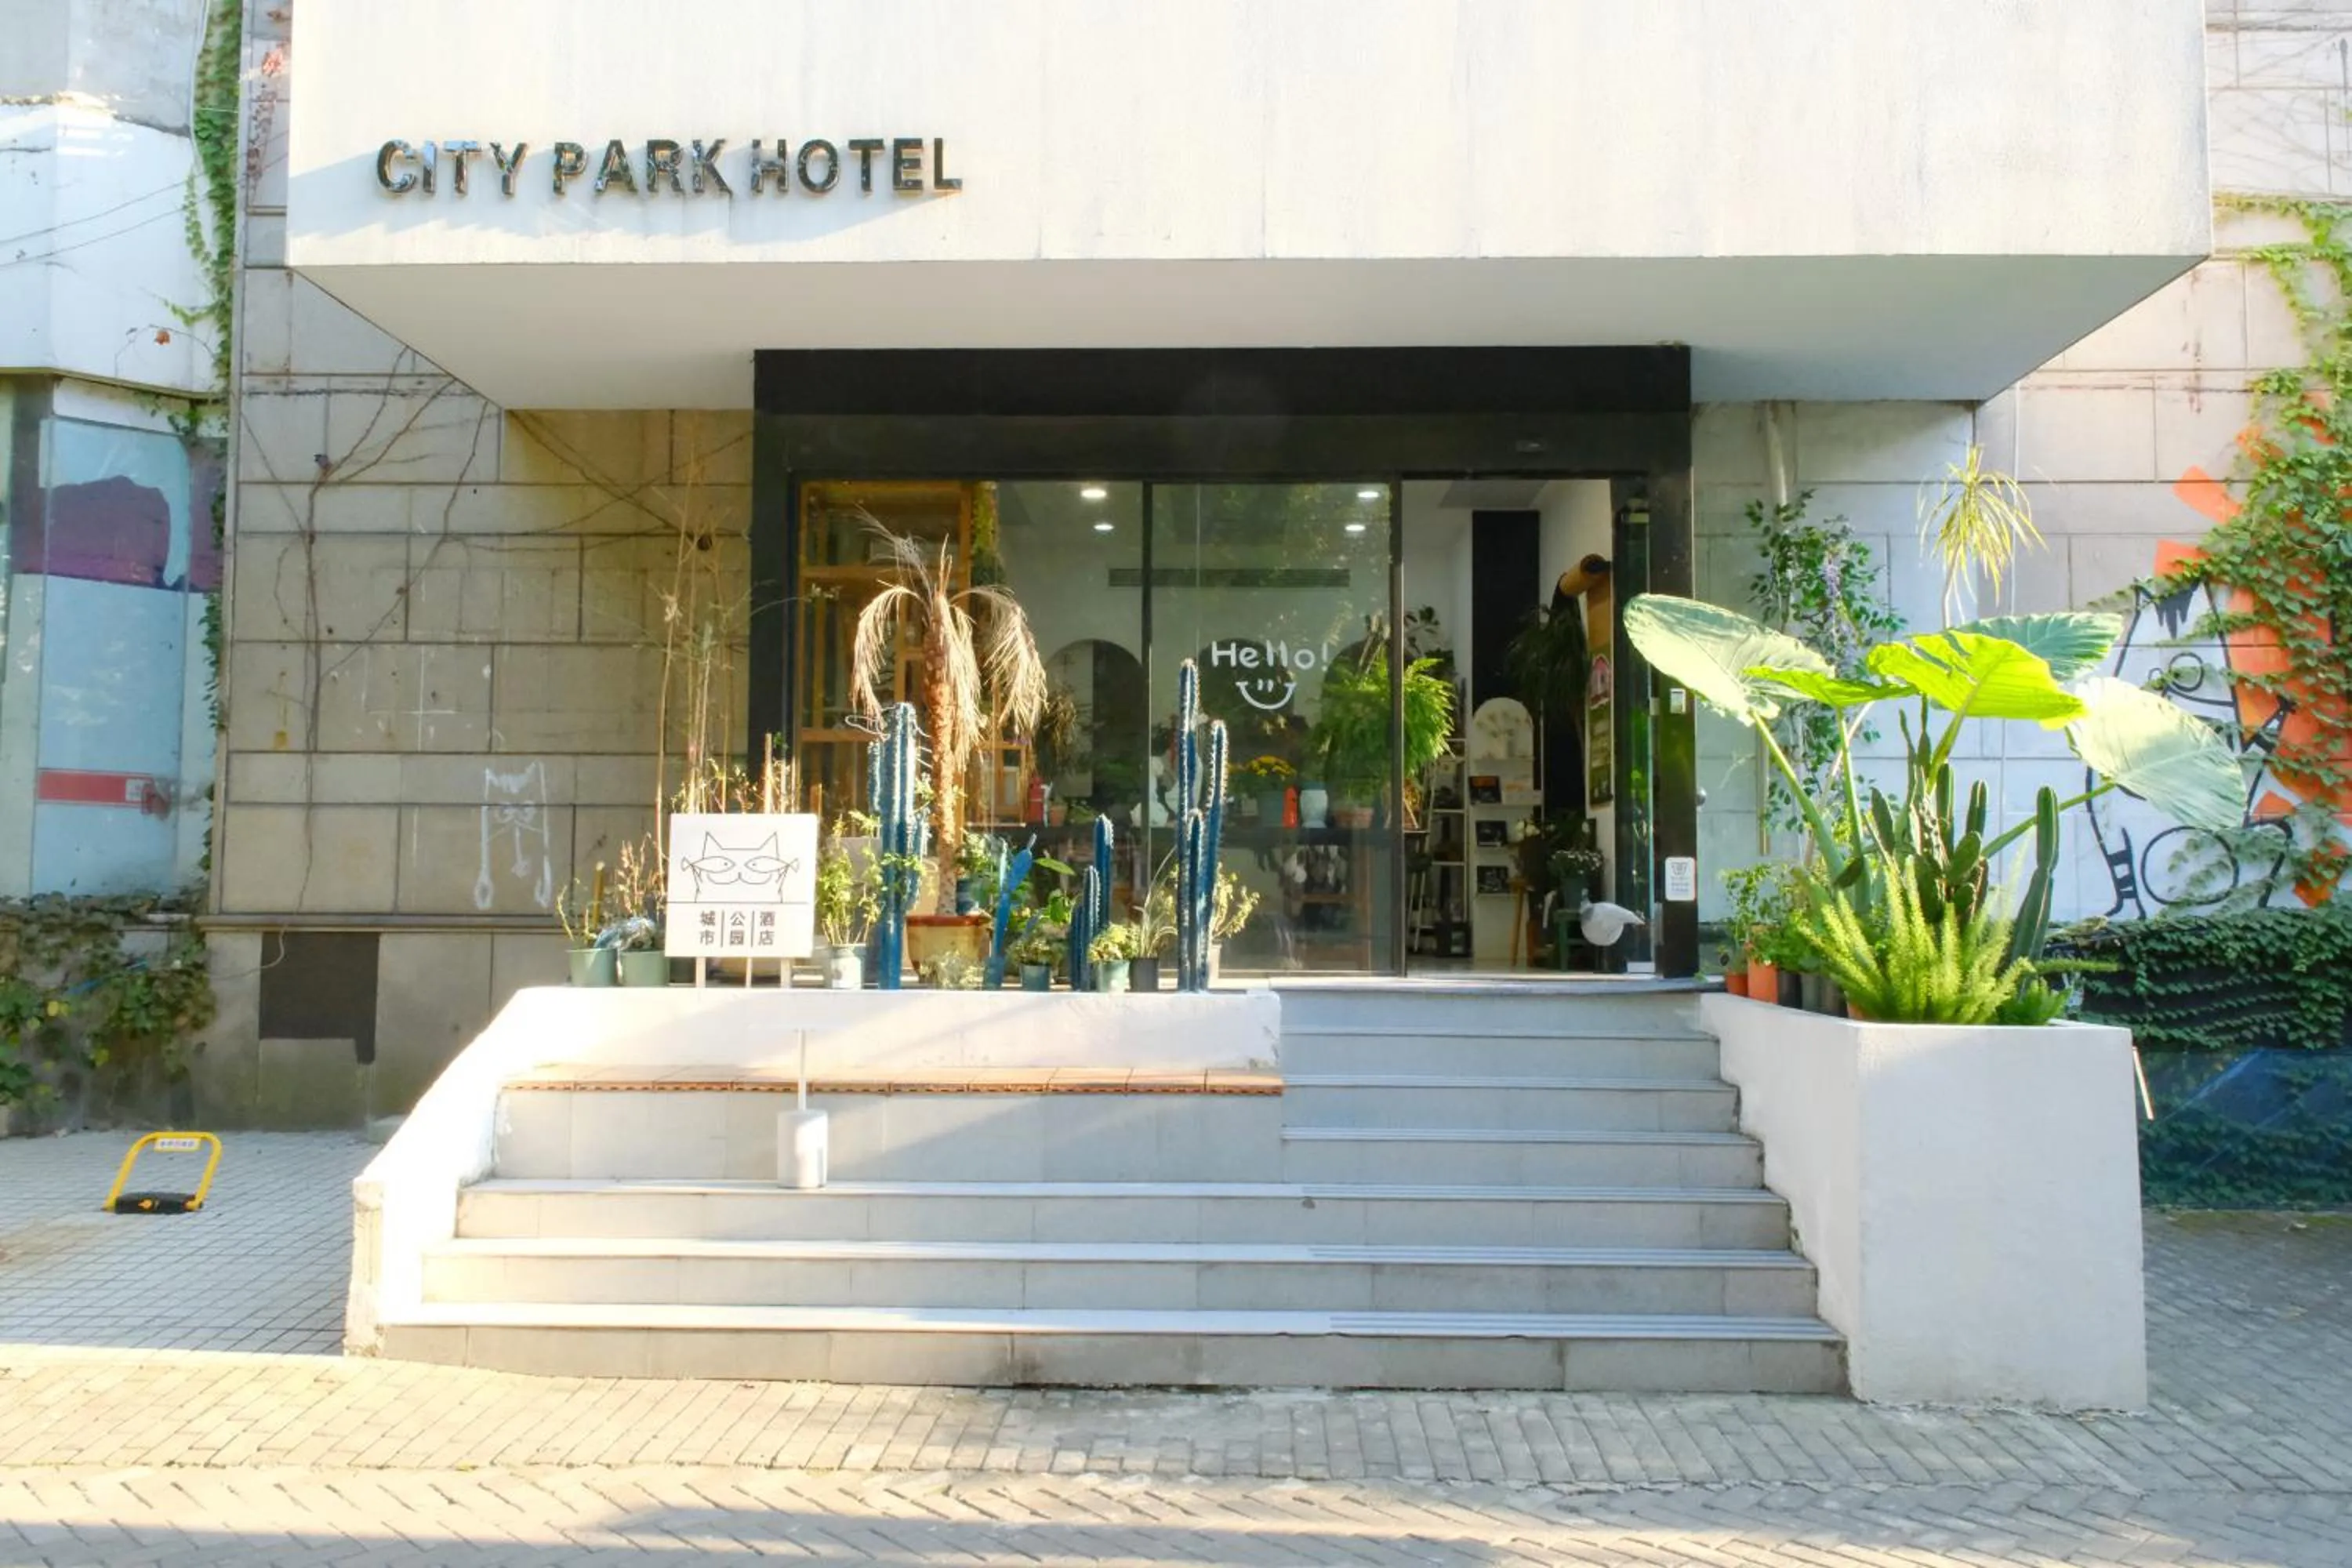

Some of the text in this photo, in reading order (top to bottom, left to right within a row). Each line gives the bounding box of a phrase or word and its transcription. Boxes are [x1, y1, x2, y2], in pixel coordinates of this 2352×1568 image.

[377, 138, 963, 195] CITY PARK HOTEL
[1211, 639, 1329, 672] Hello!
